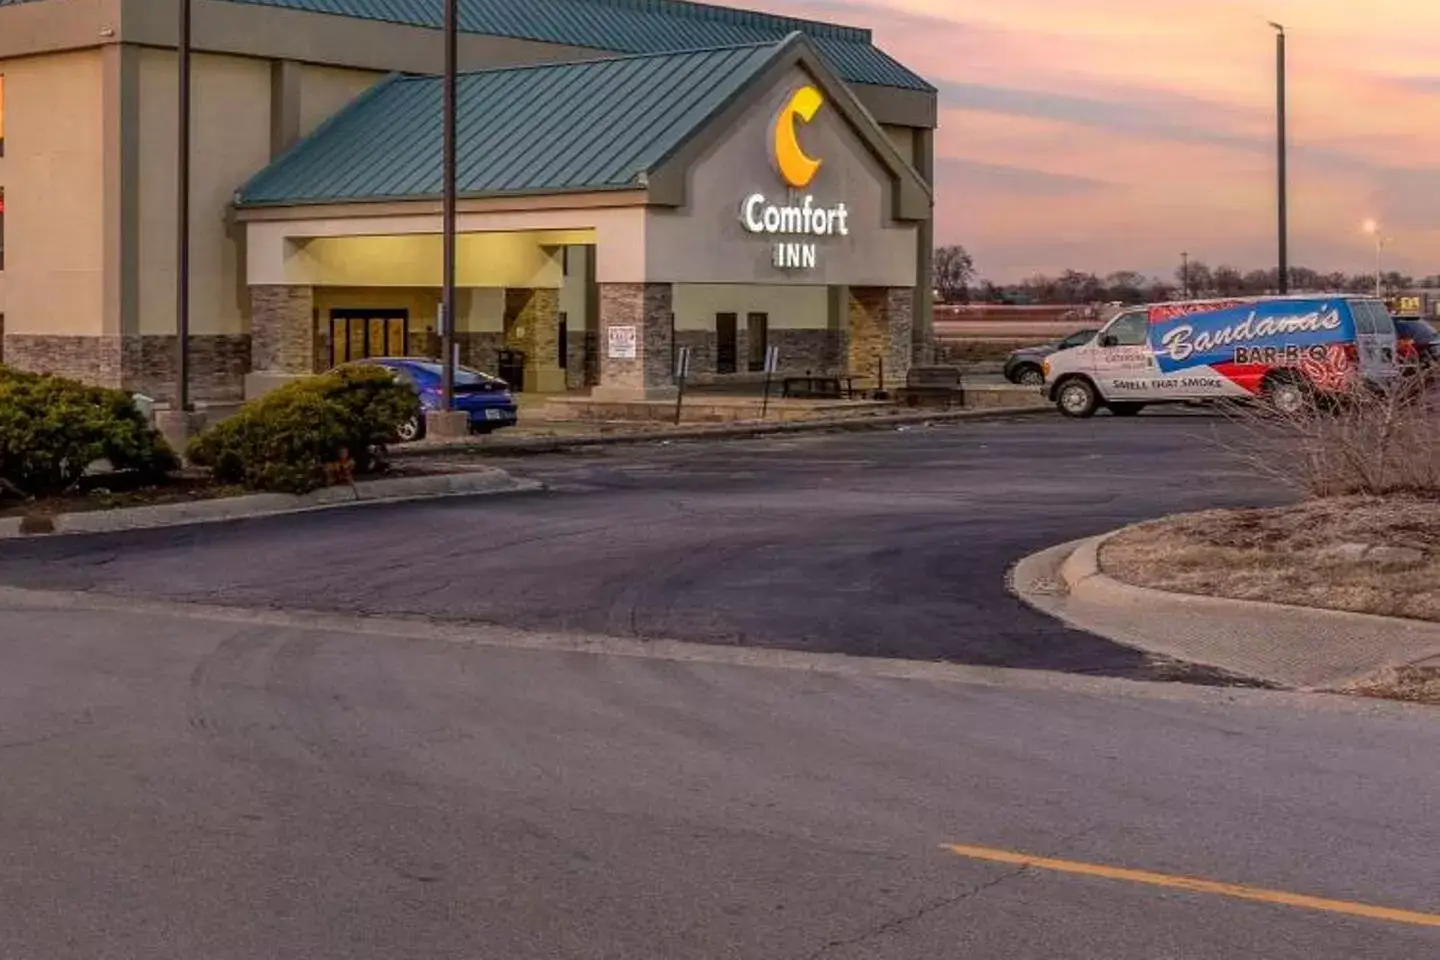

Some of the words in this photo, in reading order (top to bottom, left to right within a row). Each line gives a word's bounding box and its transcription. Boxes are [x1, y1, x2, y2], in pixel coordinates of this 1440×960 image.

[743, 193, 849, 236] Comfort
[777, 242, 816, 268] INN
[1162, 303, 1342, 360] Bandana's
[1112, 379, 1148, 390] SMELL
[1151, 379, 1178, 389] THAT
[1181, 377, 1223, 388] SMOKE
